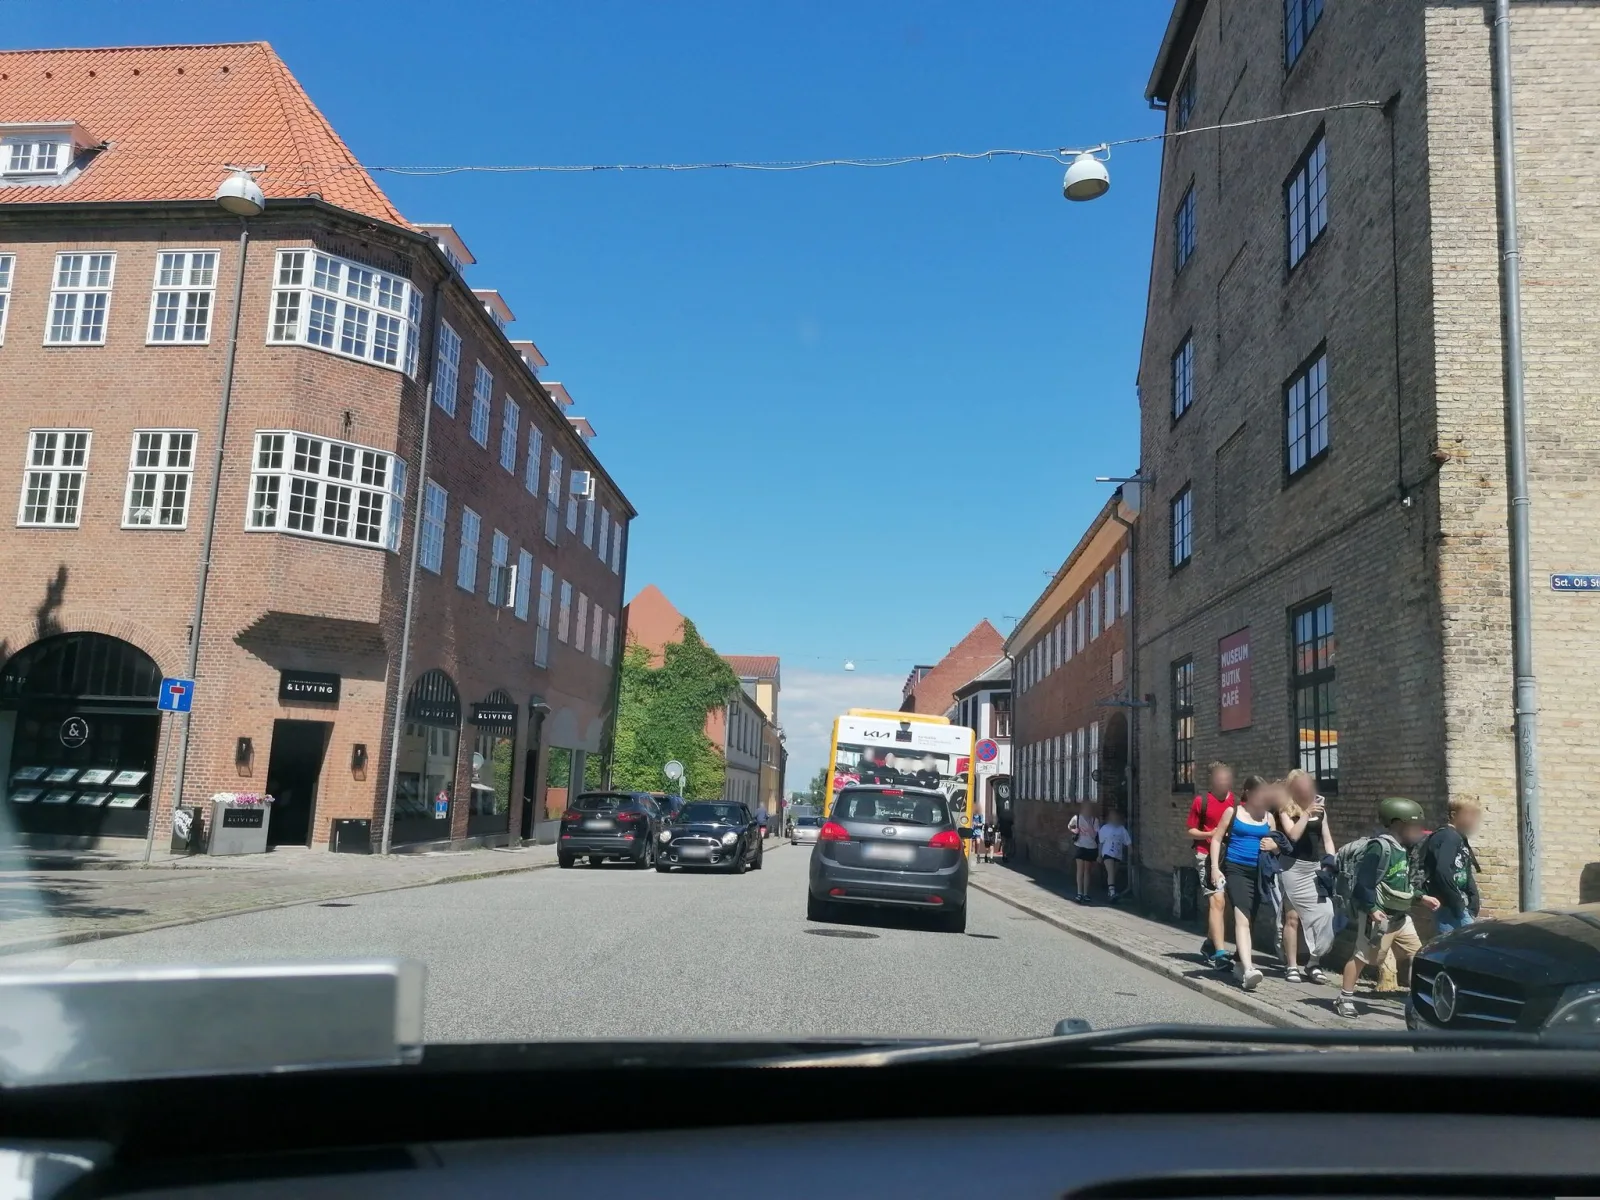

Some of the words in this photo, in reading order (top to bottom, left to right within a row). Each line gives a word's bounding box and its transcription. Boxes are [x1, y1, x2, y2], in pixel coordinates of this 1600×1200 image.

[1554, 578, 1571, 587] Sct.
[1573, 578, 1588, 587] Ols
[1221, 643, 1249, 668] MUSEUM
[1221, 668, 1241, 688] BUTIK
[287, 683, 333, 694] &LIVING
[1221, 685, 1240, 708] CAFÉ
[478, 713, 513, 721] &LIVING
